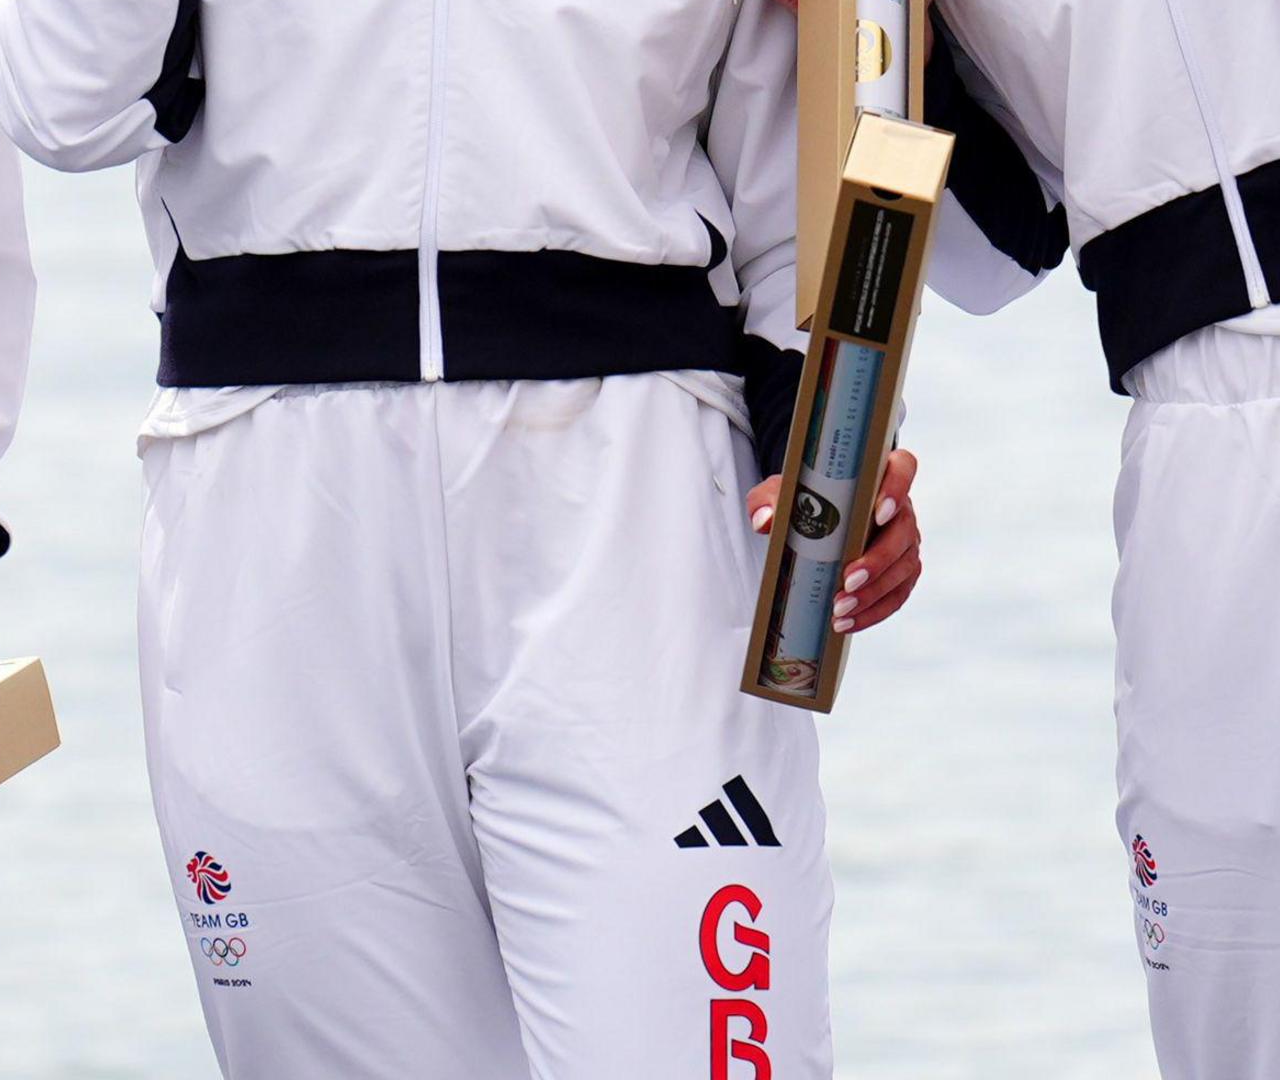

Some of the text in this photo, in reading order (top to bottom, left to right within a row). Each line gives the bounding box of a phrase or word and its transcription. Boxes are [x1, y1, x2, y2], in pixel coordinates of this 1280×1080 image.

[1152, 899, 1168, 917] GB
[190, 912, 249, 929] TEAM GB
